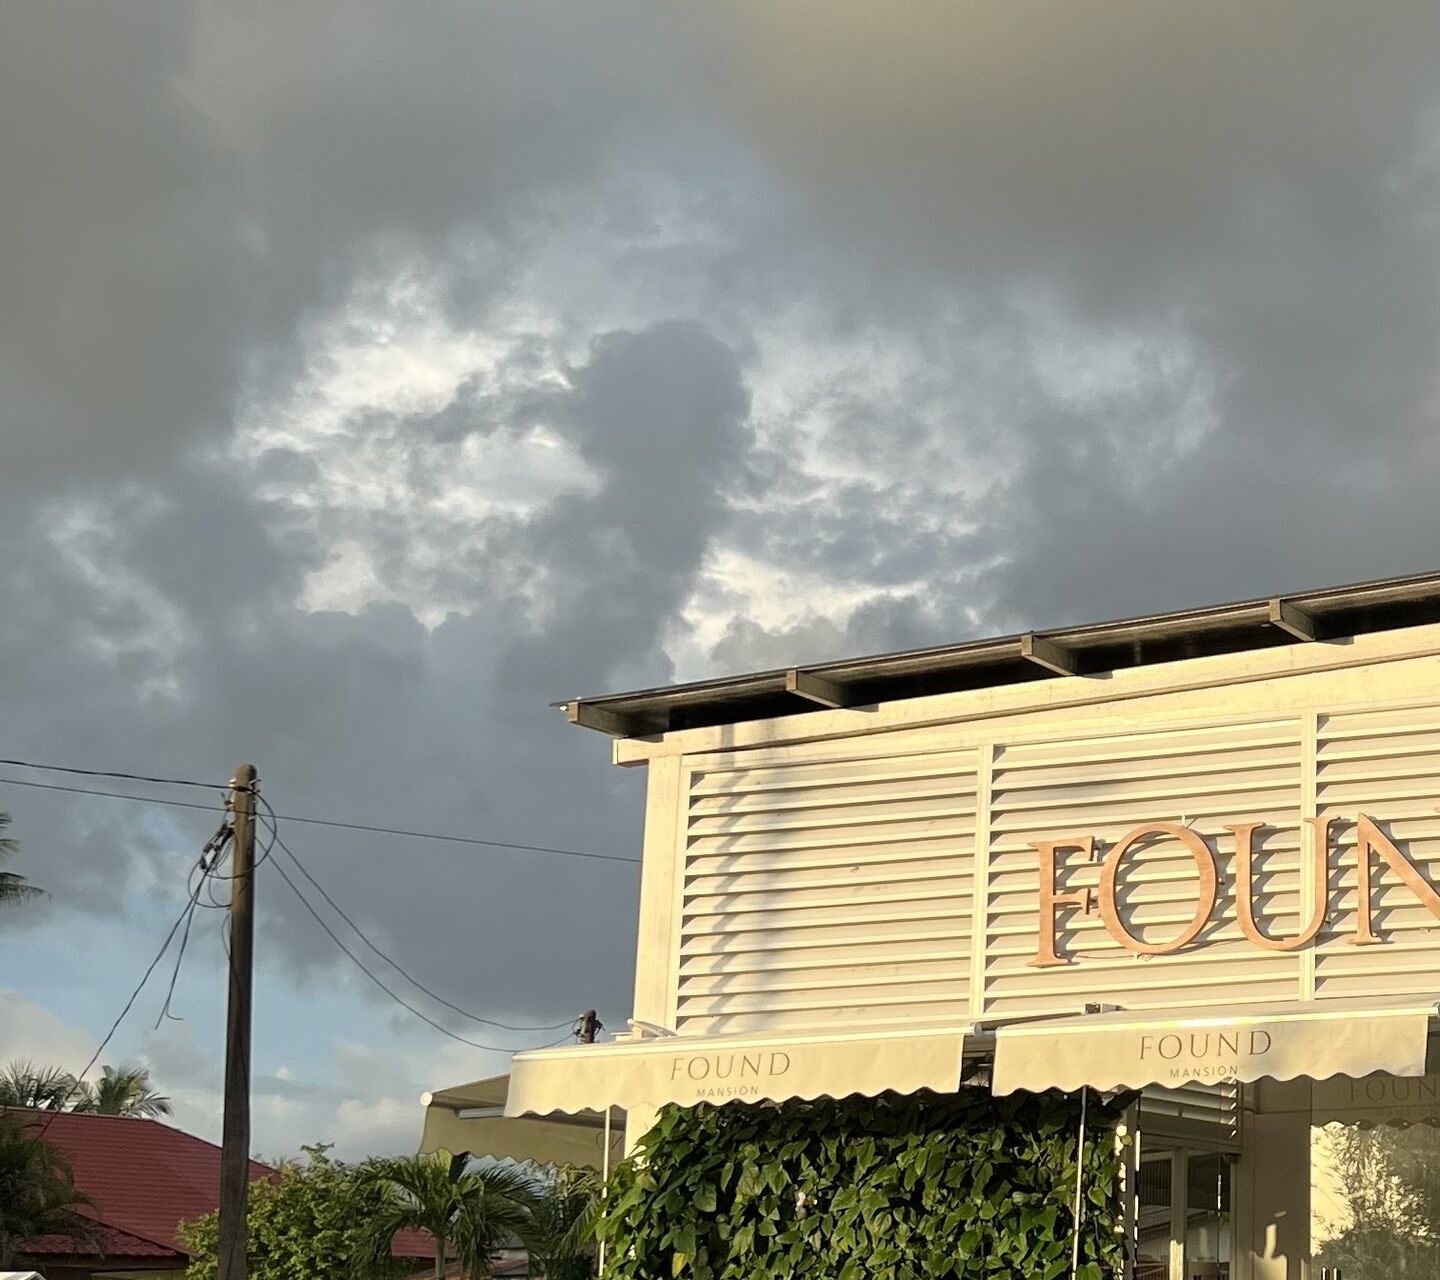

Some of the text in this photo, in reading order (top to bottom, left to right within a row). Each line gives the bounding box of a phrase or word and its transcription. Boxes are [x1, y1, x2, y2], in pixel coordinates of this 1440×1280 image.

[1139, 1030, 1272, 1060] FOUND
[669, 1052, 791, 1081] FOUND
[1169, 1066, 1238, 1079] MANSION
[696, 1086, 759, 1098] MANSION
